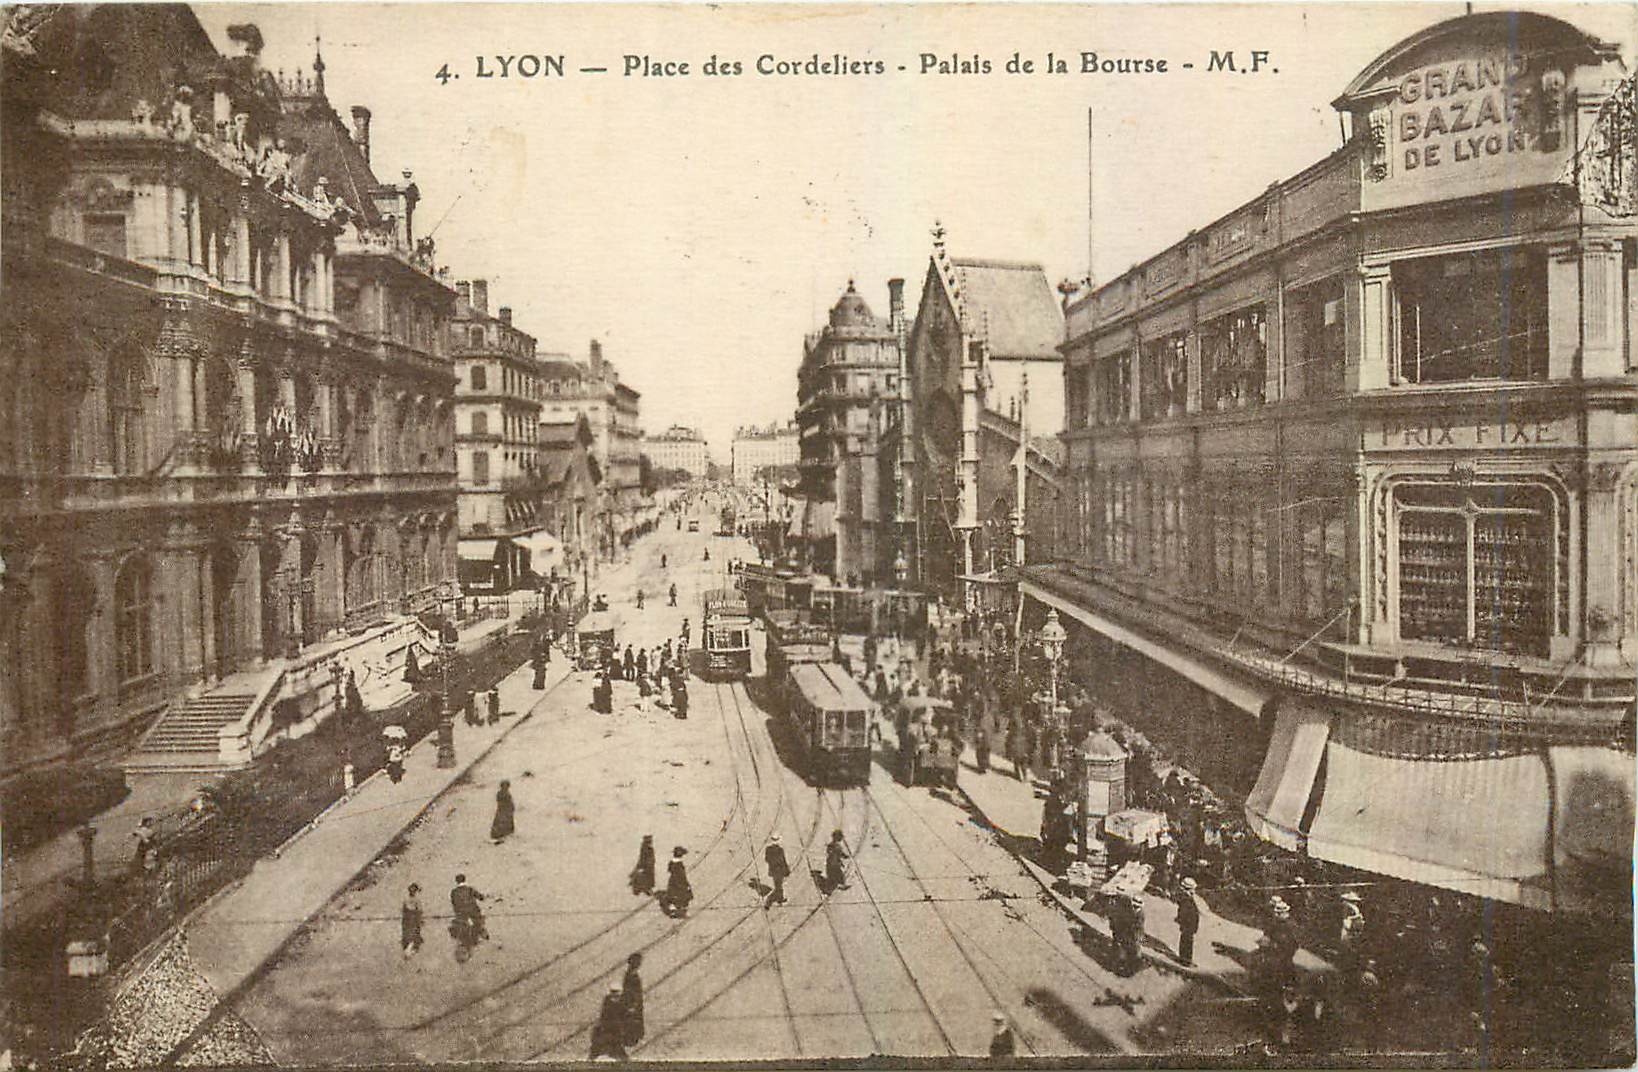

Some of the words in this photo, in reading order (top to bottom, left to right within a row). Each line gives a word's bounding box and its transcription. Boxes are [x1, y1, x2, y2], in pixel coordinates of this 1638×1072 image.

[1405, 145, 1441, 170] DE
[1454, 129, 1526, 162] LYON
[1382, 421, 1454, 446] PRIX
[1475, 420, 1560, 444] FIXE
